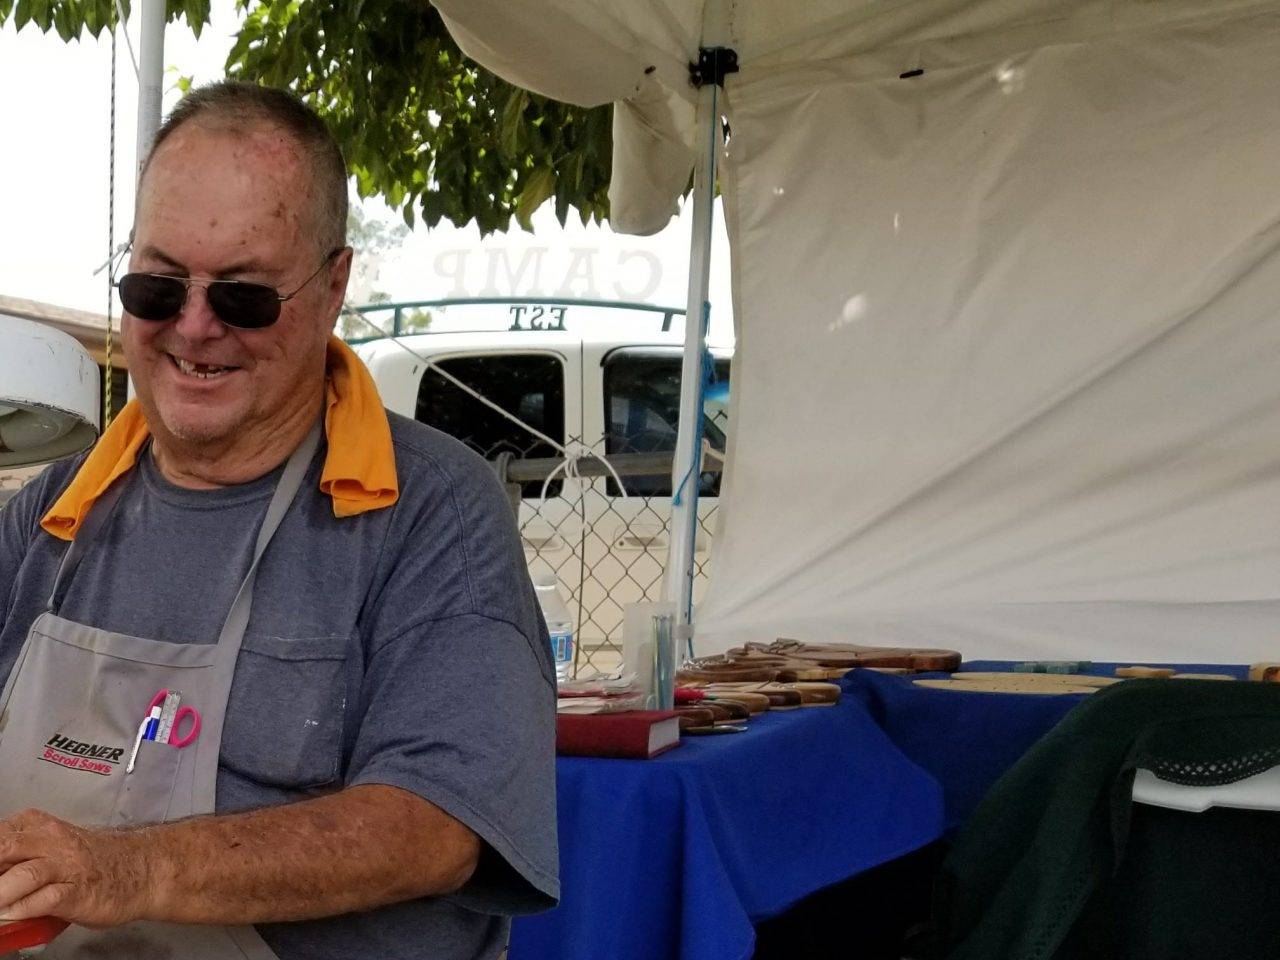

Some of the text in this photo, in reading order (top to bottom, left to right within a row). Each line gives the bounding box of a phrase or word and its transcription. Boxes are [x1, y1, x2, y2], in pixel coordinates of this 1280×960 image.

[43, 747, 112, 774] Scroll Saws
[46, 733, 125, 761] HEGNER
